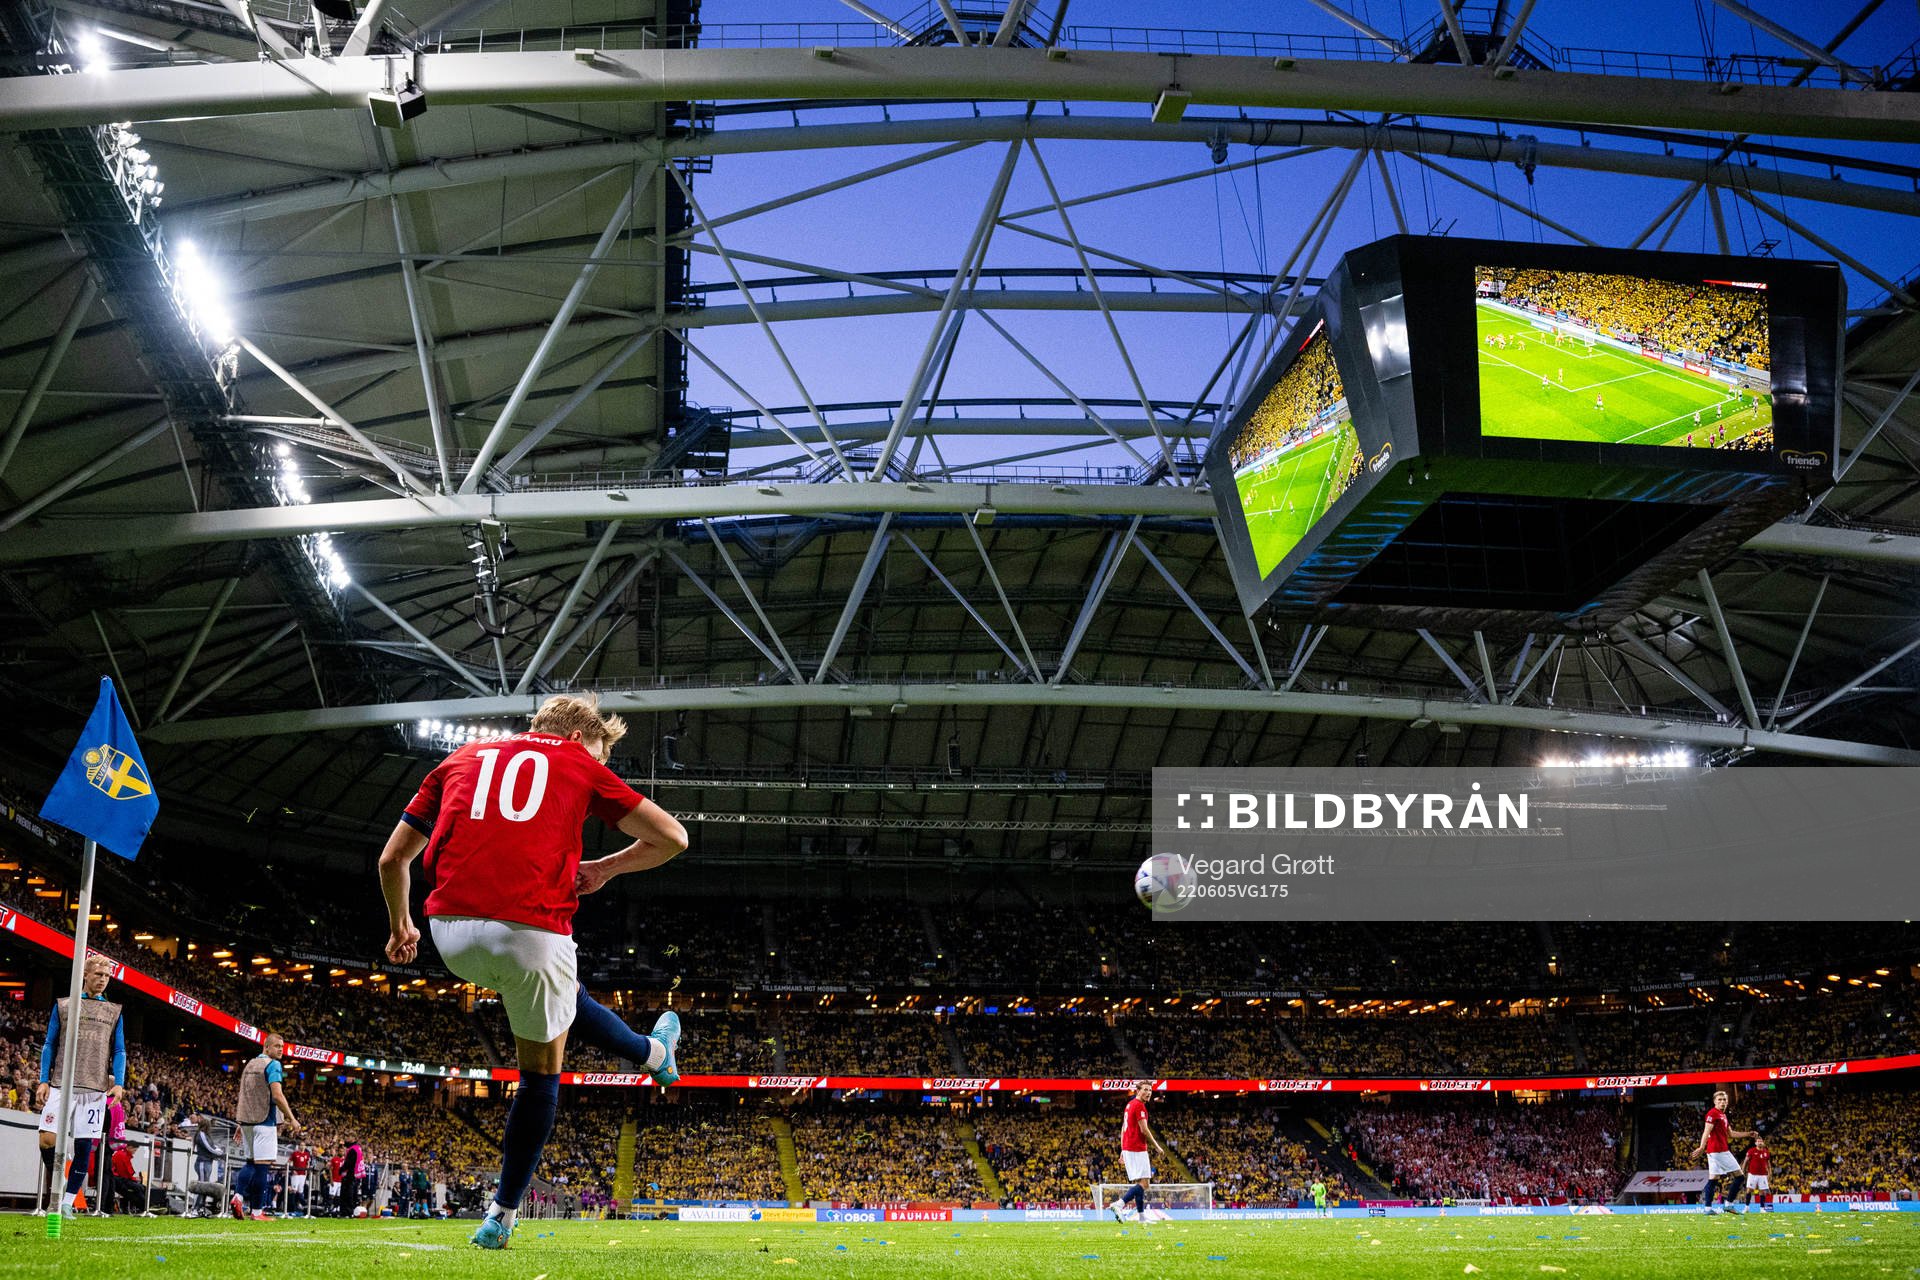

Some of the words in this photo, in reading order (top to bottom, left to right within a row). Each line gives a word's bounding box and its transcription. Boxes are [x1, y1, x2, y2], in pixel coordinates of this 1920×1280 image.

[1786, 455, 1821, 466] friends
[470, 748, 549, 822] 10
[439, 1066, 446, 1076] 2
[468, 1068, 488, 1079] NOR
[1778, 1063, 1837, 1079] ODDSET
[583, 1073, 642, 1085] ODDSET
[758, 1076, 817, 1088] ODDSET
[932, 1078, 991, 1090] ODDSET
[1597, 1075, 1657, 1087] ODDSET
[1268, 1080, 1323, 1091] ODDSET
[1429, 1080, 1482, 1091] ODDSET
[87, 1109, 101, 1125] 21
[681, 1210, 746, 1220] CAVALIERE
[891, 1211, 947, 1221] BAUHAUS
[1044, 1210, 1084, 1218] FOTBOLL
[1201, 1211, 1228, 1220] Ladda
[1480, 1207, 1496, 1215] MIN
[1496, 1207, 1534, 1215] FOTBOLL
[844, 1213, 876, 1222] OBOS
